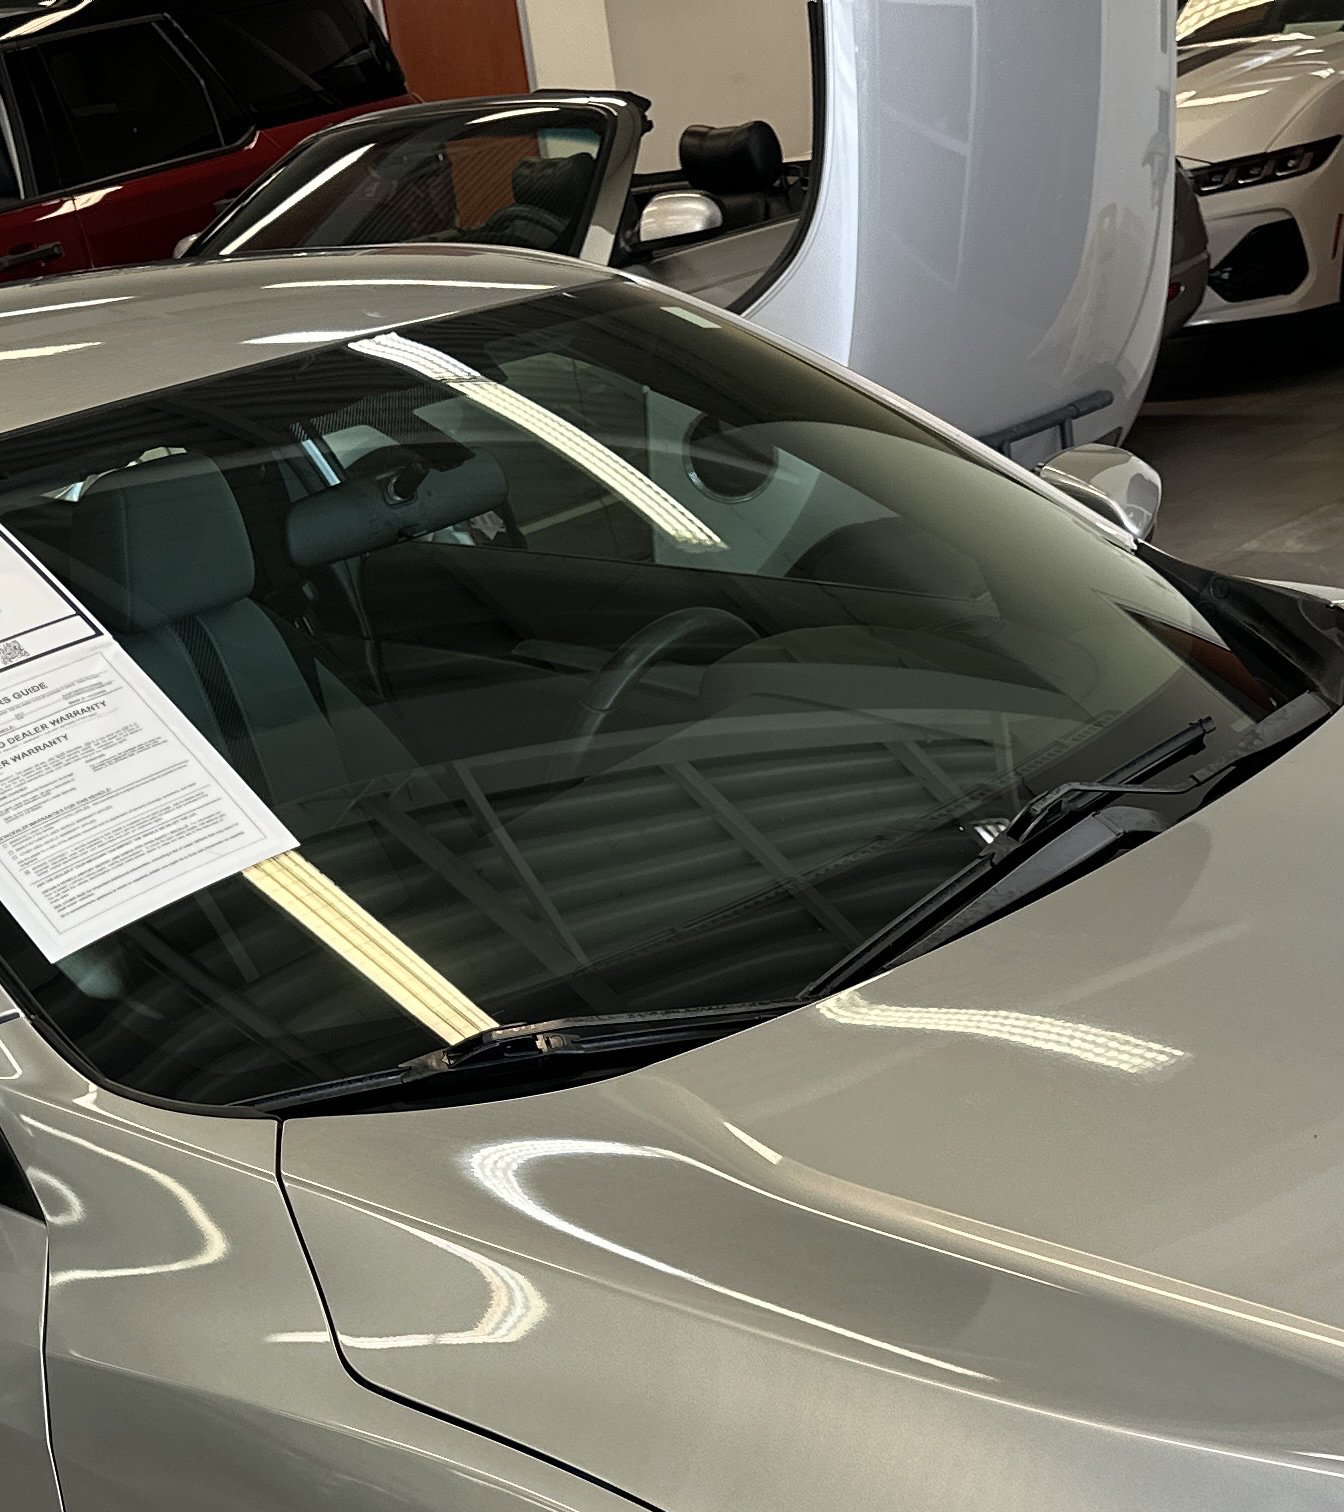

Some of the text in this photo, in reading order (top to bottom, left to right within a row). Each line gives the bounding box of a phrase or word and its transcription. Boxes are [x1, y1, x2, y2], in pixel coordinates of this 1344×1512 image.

[13, 682, 49, 701] GUIDE
[6, 724, 49, 744] DEALER
[49, 700, 108, 726] WARRANTY
[10, 733, 69, 762] WARRANTY
